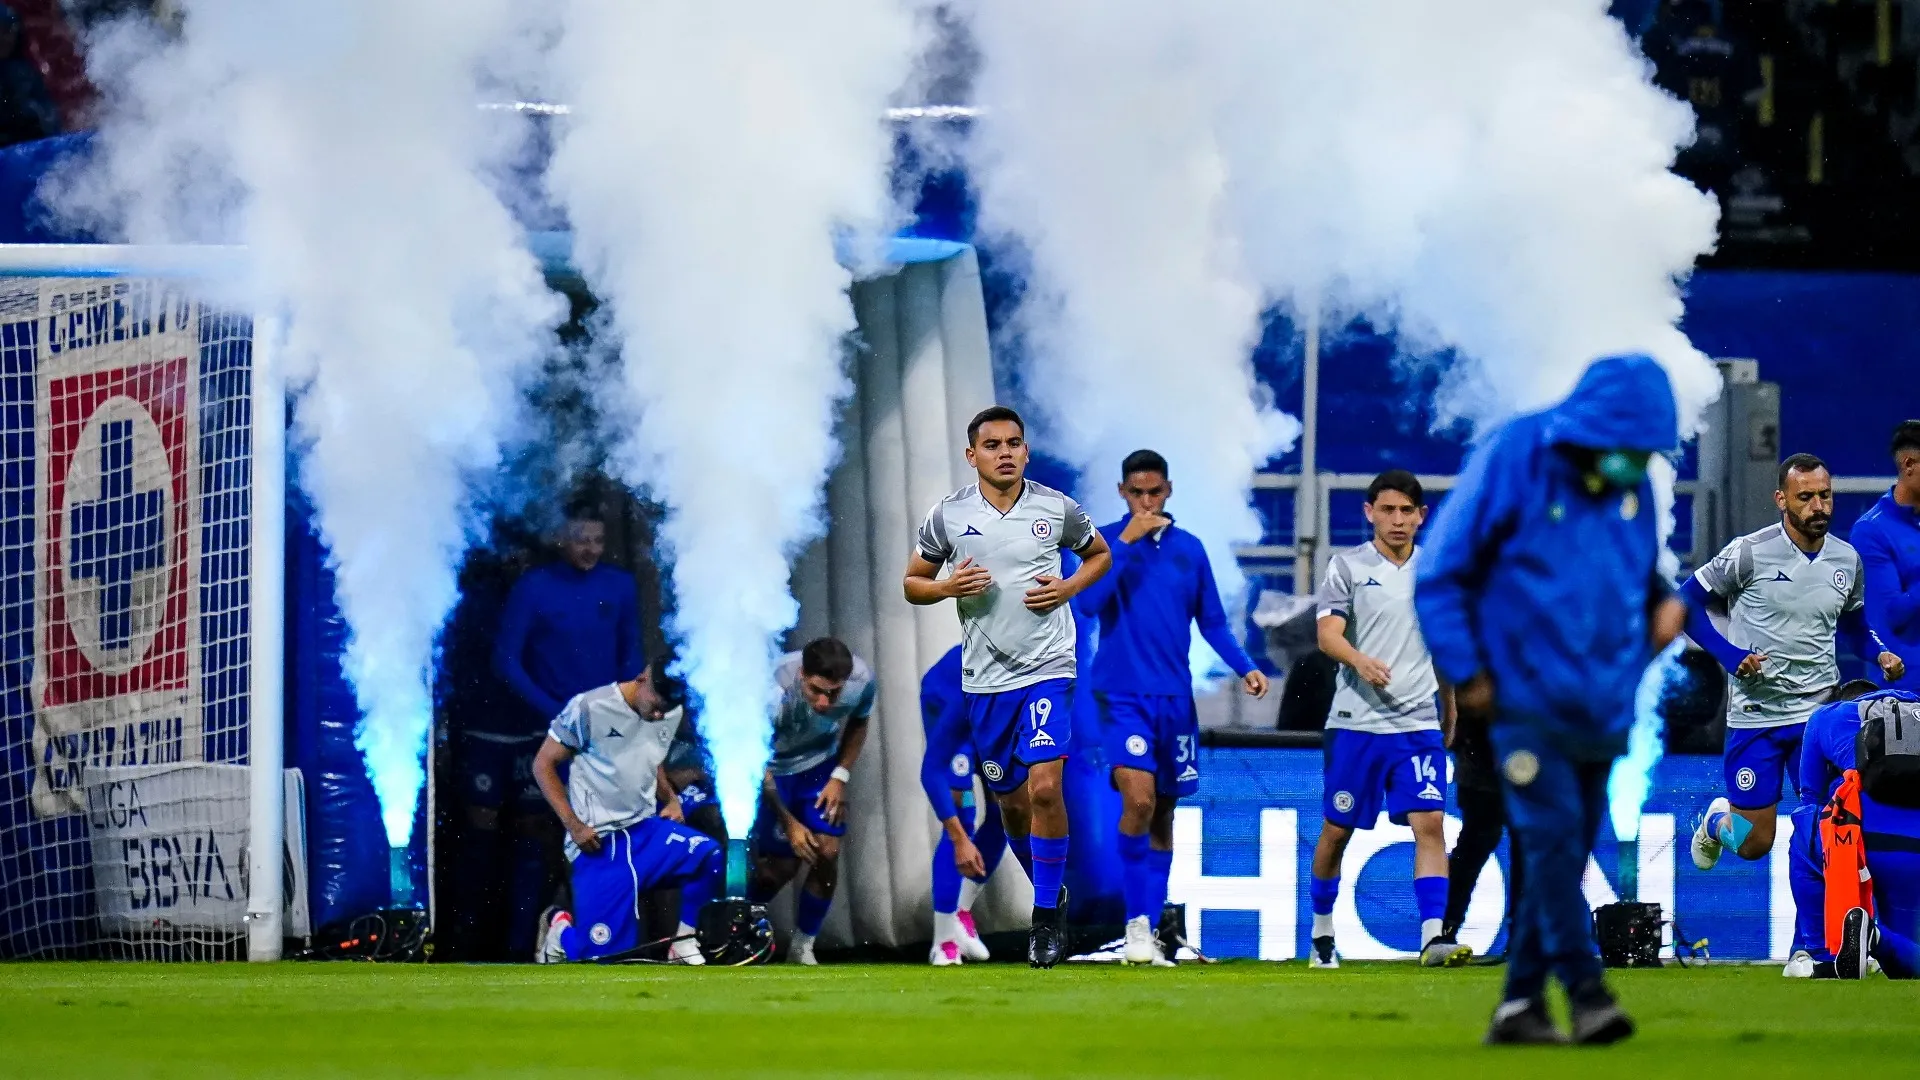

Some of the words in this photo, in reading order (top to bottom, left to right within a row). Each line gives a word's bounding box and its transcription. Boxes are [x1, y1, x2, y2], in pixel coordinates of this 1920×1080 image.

[1030, 698, 1052, 730] 19
[1176, 734, 1195, 762] 31
[1411, 755, 1437, 782] 14
[88, 781, 147, 830] LIGA
[122, 828, 235, 909] BBVA
